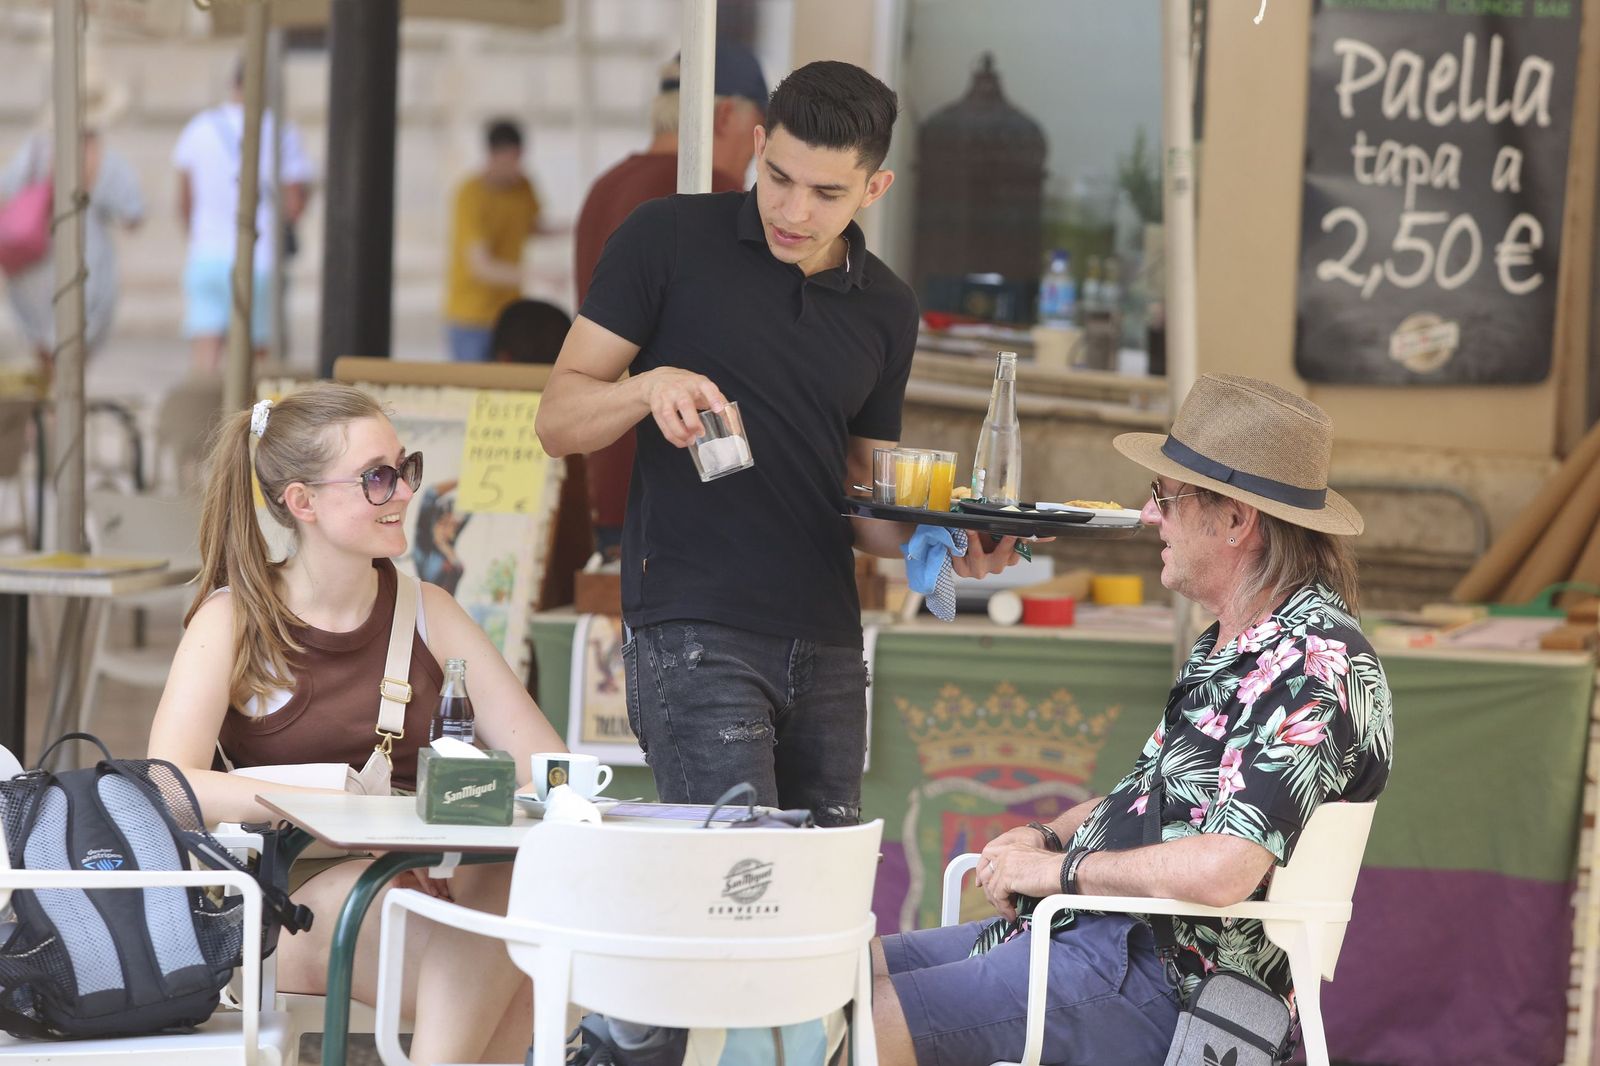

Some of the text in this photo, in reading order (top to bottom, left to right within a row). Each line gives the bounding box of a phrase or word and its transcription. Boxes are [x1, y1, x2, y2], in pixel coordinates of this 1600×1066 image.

[1534, 0, 1572, 17] BAR
[1333, 33, 1554, 127] Paella
[1352, 130, 1523, 210] tapa a
[1316, 206, 1544, 298] 2,50 €
[472, 465, 504, 508] 5
[708, 905, 779, 914] CERVEZAS
